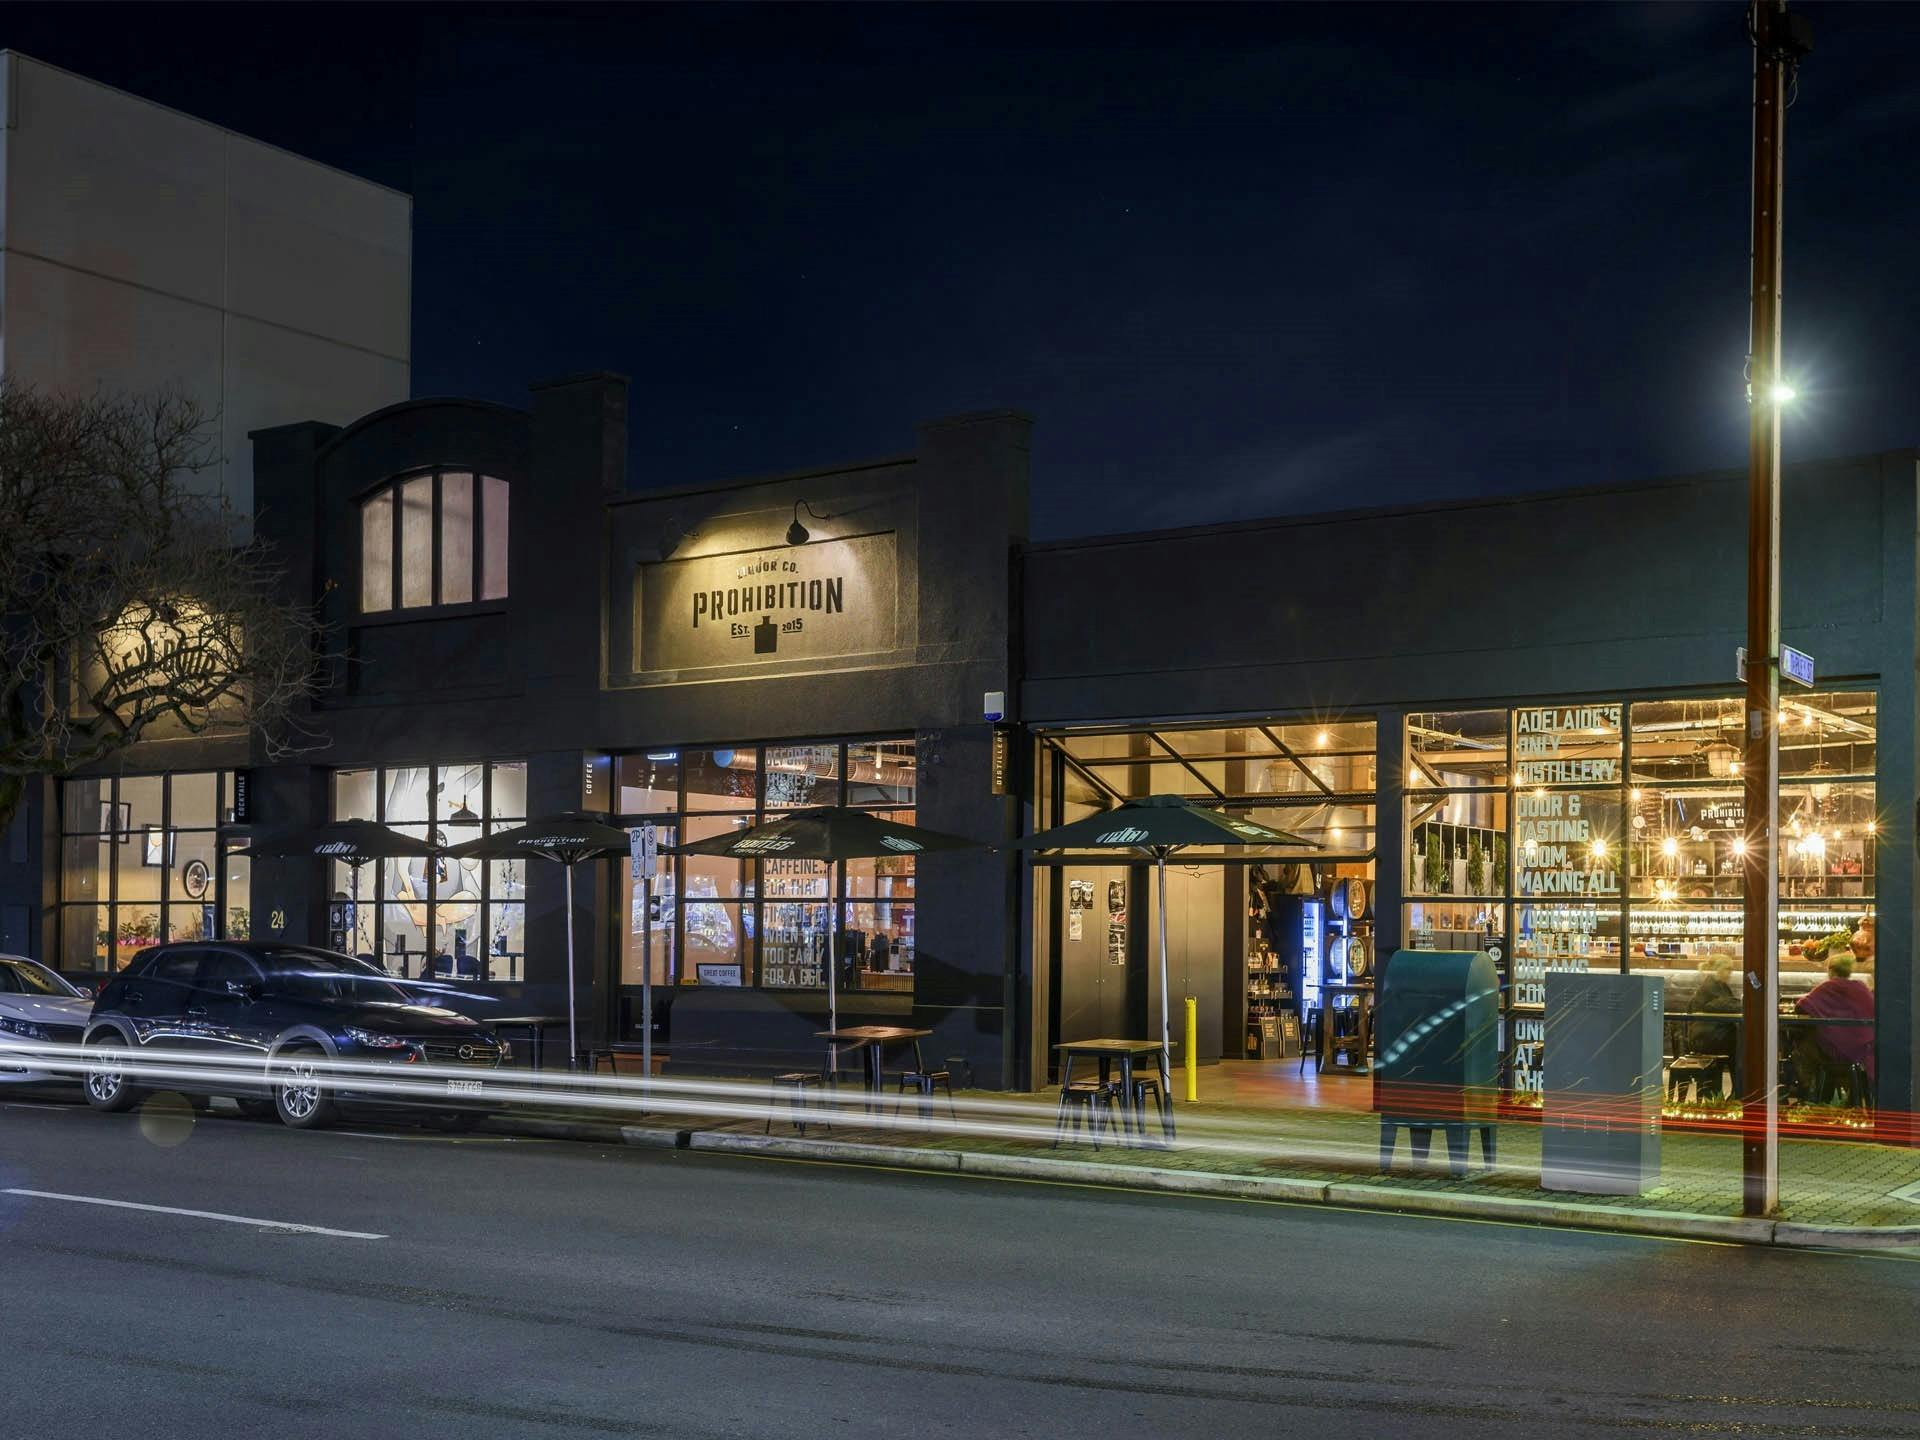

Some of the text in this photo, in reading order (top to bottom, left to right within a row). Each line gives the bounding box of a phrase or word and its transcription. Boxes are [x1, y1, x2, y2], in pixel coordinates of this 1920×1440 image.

[782, 561, 799, 574] CO.
[693, 576, 843, 628] PROHIBITION
[782, 618, 803, 631] 2015
[1518, 707, 1620, 733] ADELAIDE'S
[1518, 734, 1560, 757] ONLY
[1517, 759, 1616, 783] DISTILLERY
[1517, 794, 1580, 817] DOOR &
[631, 829, 641, 842] 2P
[1517, 820, 1589, 843] TASTING
[764, 879, 818, 895] FOR THAT
[1516, 871, 1620, 893] MAKING ALL
[271, 911, 285, 929] 24
[764, 947, 825, 965] TOO EARLY
[762, 968, 784, 985] FOR
[788, 968, 796, 984] A
[1514, 1044, 1534, 1066] AT
